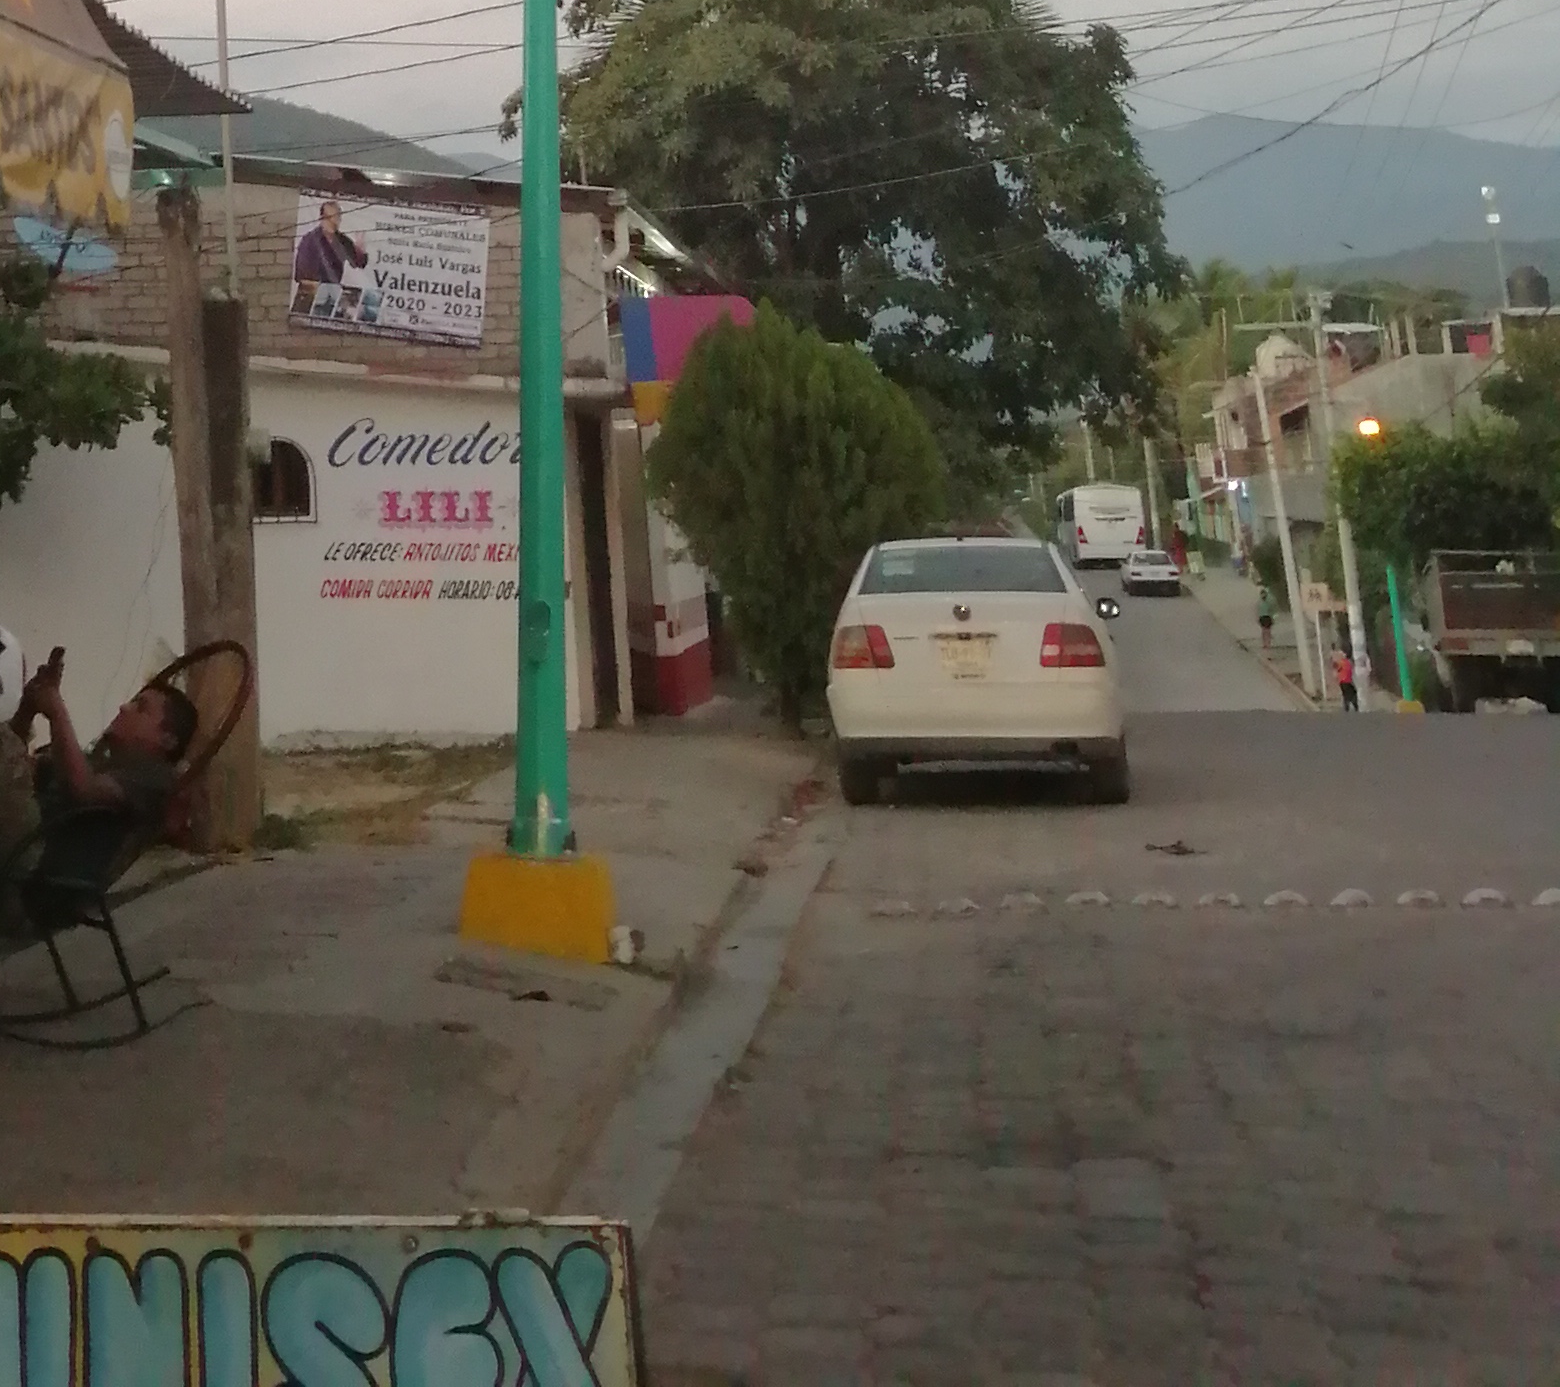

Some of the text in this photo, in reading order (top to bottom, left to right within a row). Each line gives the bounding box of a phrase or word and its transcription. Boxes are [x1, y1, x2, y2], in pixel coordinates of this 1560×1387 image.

[376, 250, 482, 274] José Luis Vargas
[373, 269, 482, 300] Valenzuela
[386, 294, 426, 311] 2020
[444, 302, 482, 318] 2023
[379, 488, 494, 527] LILI
[324, 542, 340, 561] LE
[403, 543, 480, 562] ANTOJITOS
[320, 578, 371, 600] COMIDA
[376, 579, 433, 600] CORRIDA
